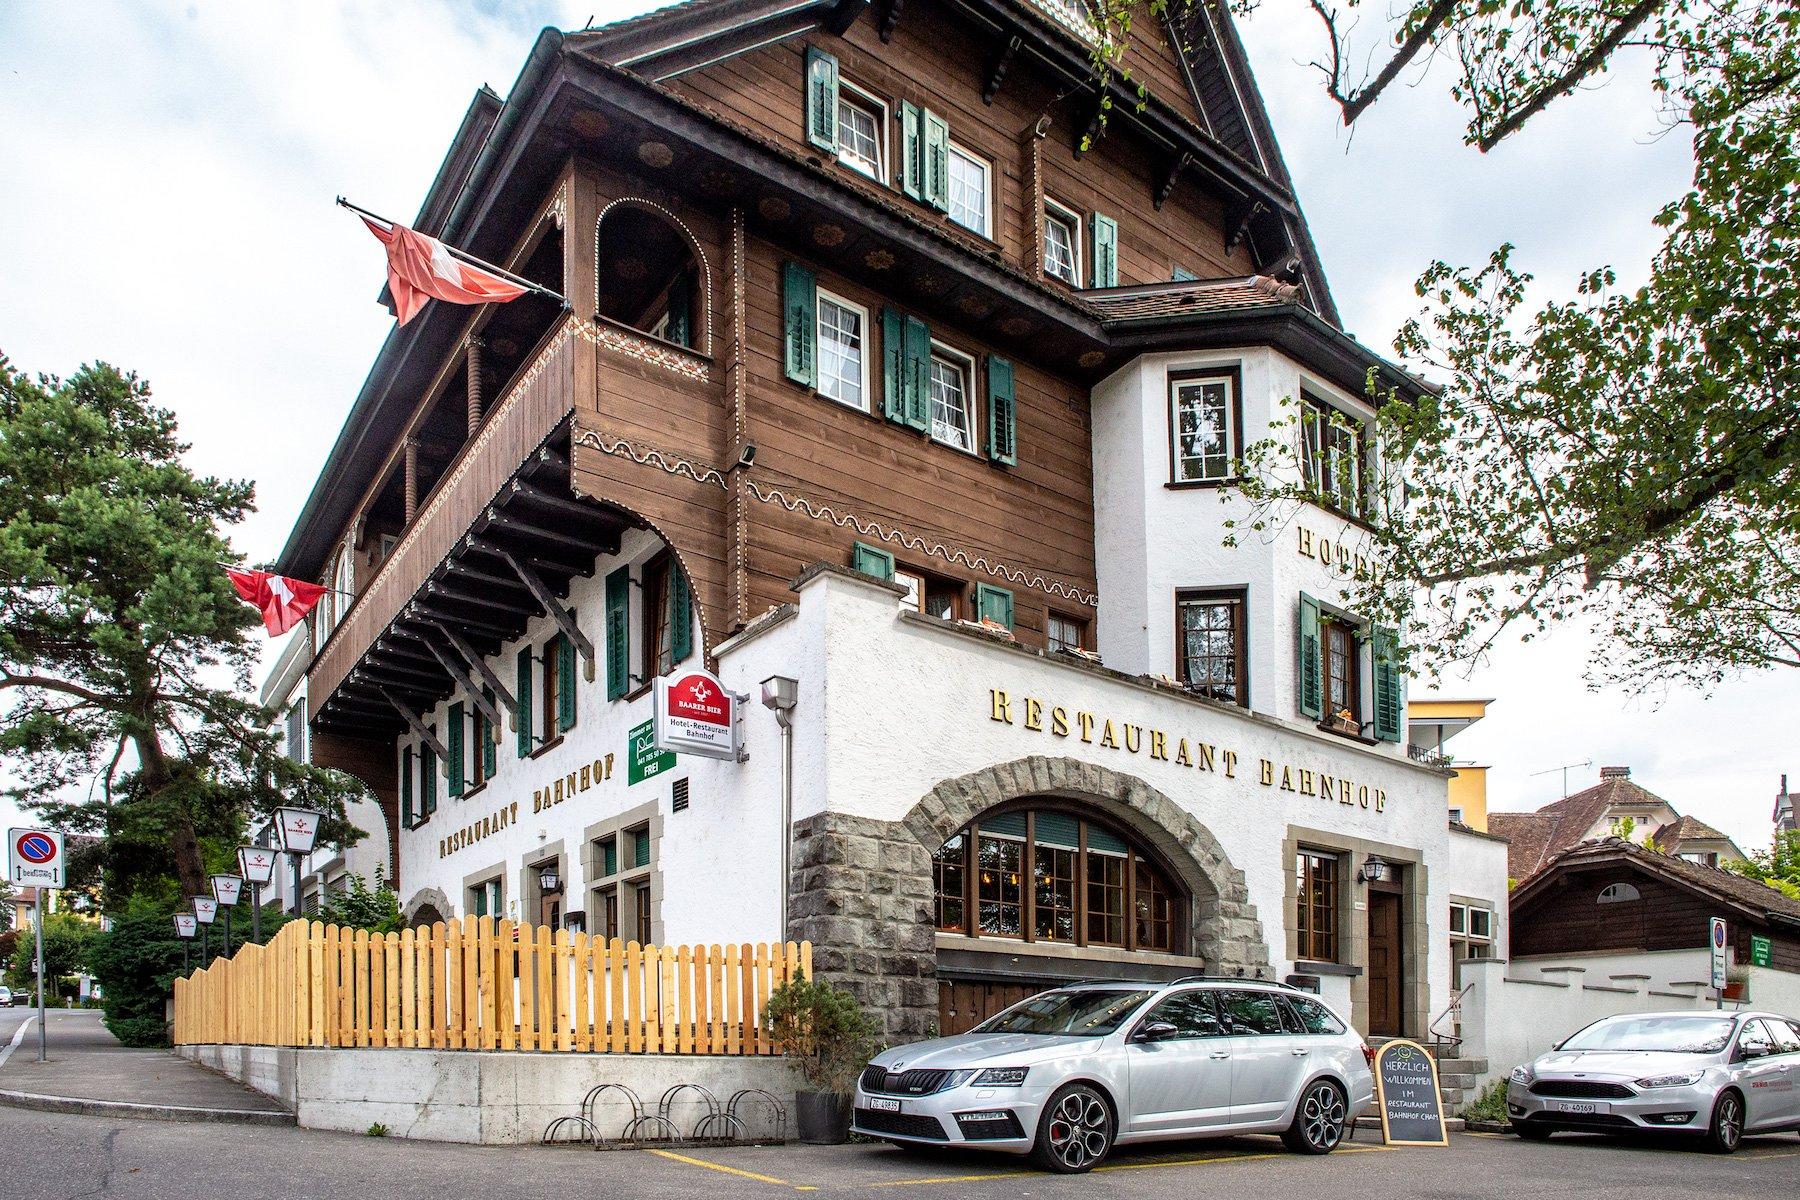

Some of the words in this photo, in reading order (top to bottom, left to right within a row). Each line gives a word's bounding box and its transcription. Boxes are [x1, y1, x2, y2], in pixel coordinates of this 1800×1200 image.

[678, 700, 706, 711] BAARER
[707, 705, 722, 715] BIER
[670, 718, 729, 736] Hotel-Restaurant
[686, 729, 715, 741] Bahnhof
[990, 688, 1238, 778] RESTAURANT
[1260, 758, 1386, 813] BAHNHOF
[644, 761, 659, 777] FREI
[439, 801, 518, 859] RESTAURANT
[532, 752, 615, 814] BAHNHOF
[1385, 1061, 1429, 1072] HERZLICH
[1384, 1075, 1432, 1086] WILLKOMMEN
[1402, 1090, 1415, 1098] IM
[1387, 1100, 1431, 1109] RESTAURANT
[1388, 1111, 1419, 1120] BAHNHOF
[1420, 1113, 1439, 1121] CHAM
